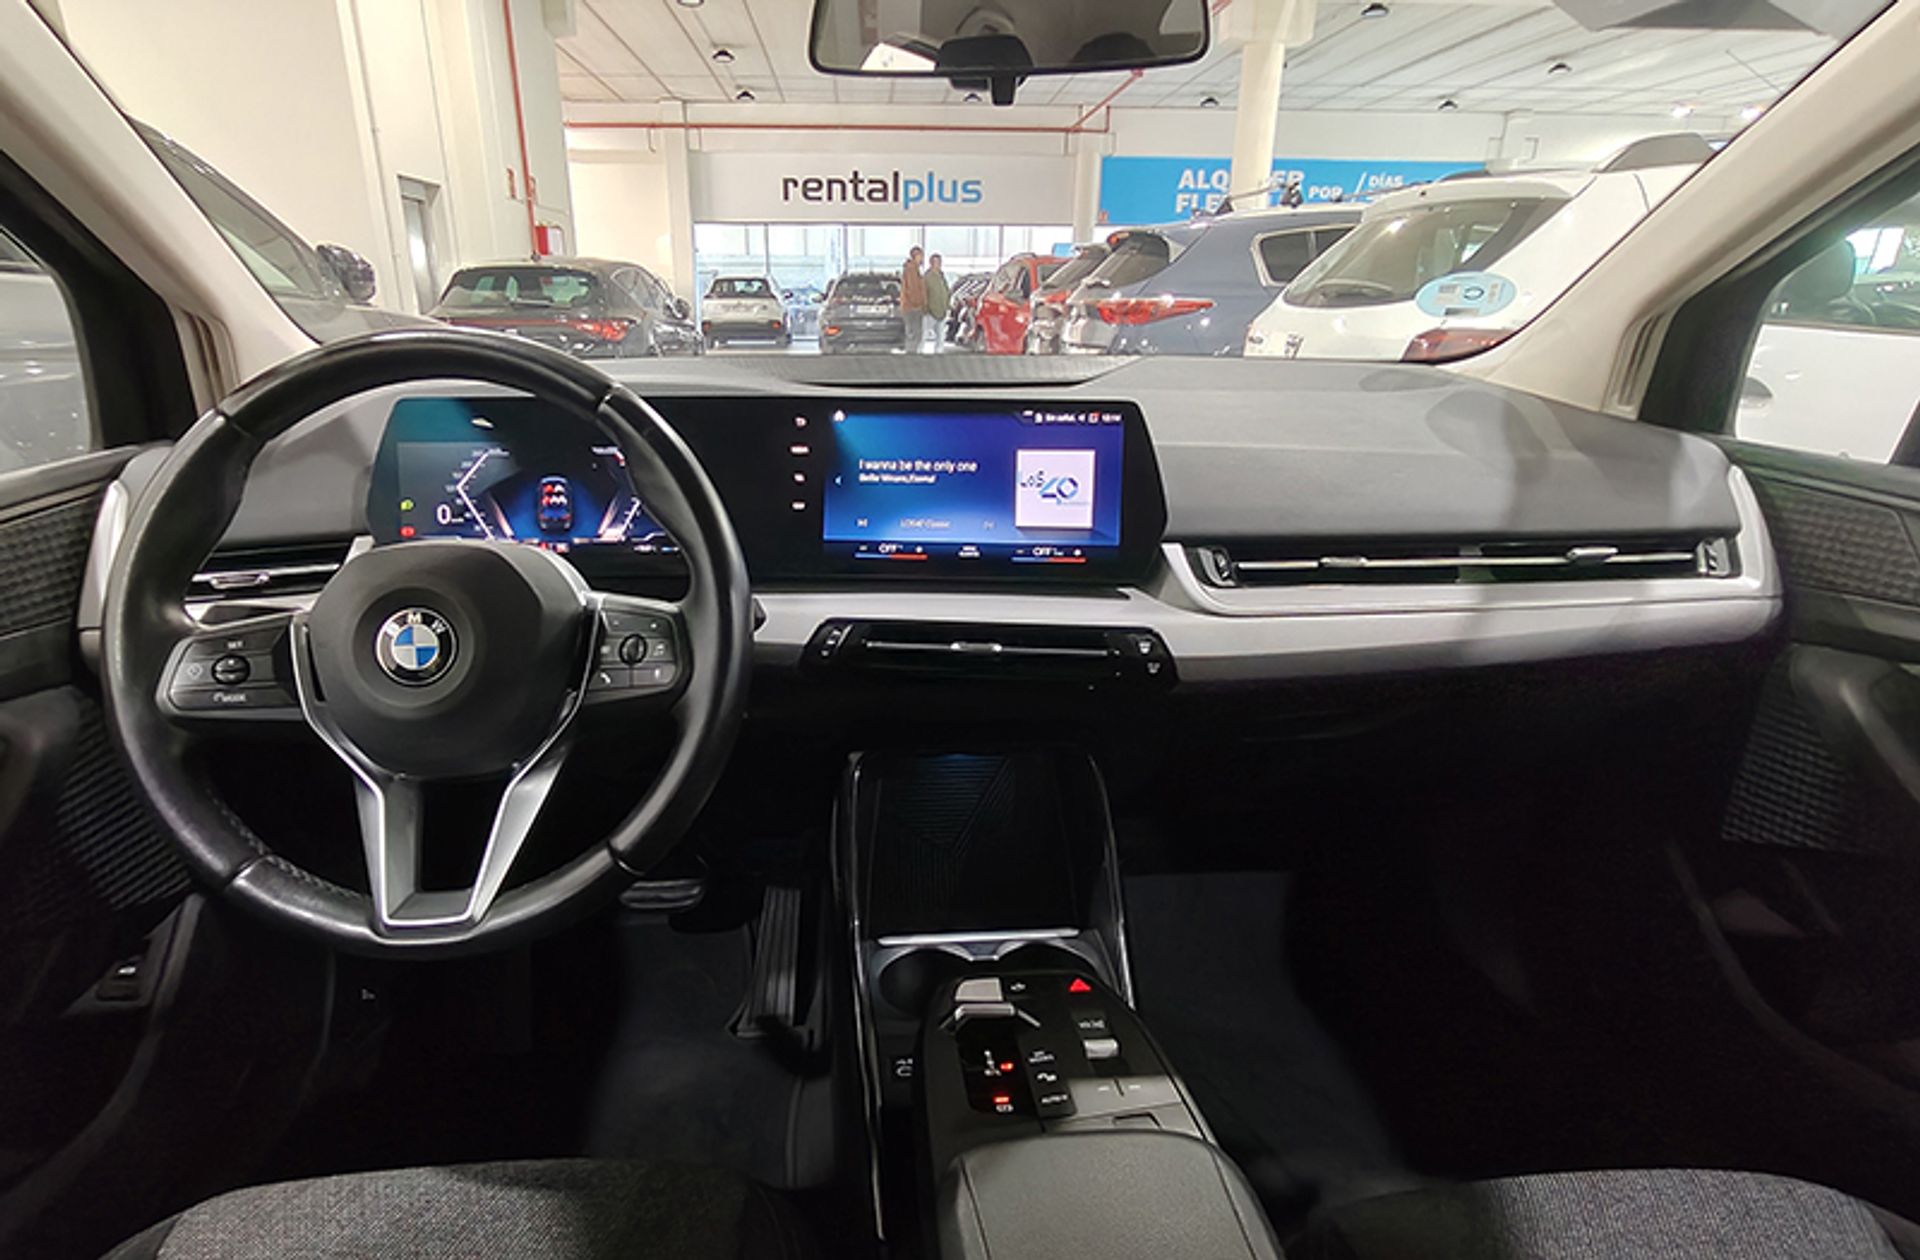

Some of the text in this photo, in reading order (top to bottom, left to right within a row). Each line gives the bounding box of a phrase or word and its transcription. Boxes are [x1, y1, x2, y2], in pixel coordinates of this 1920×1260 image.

[782, 170, 983, 210] rentalplus
[436, 504, 452, 525] 0
[385, 610, 446, 636] BMW
